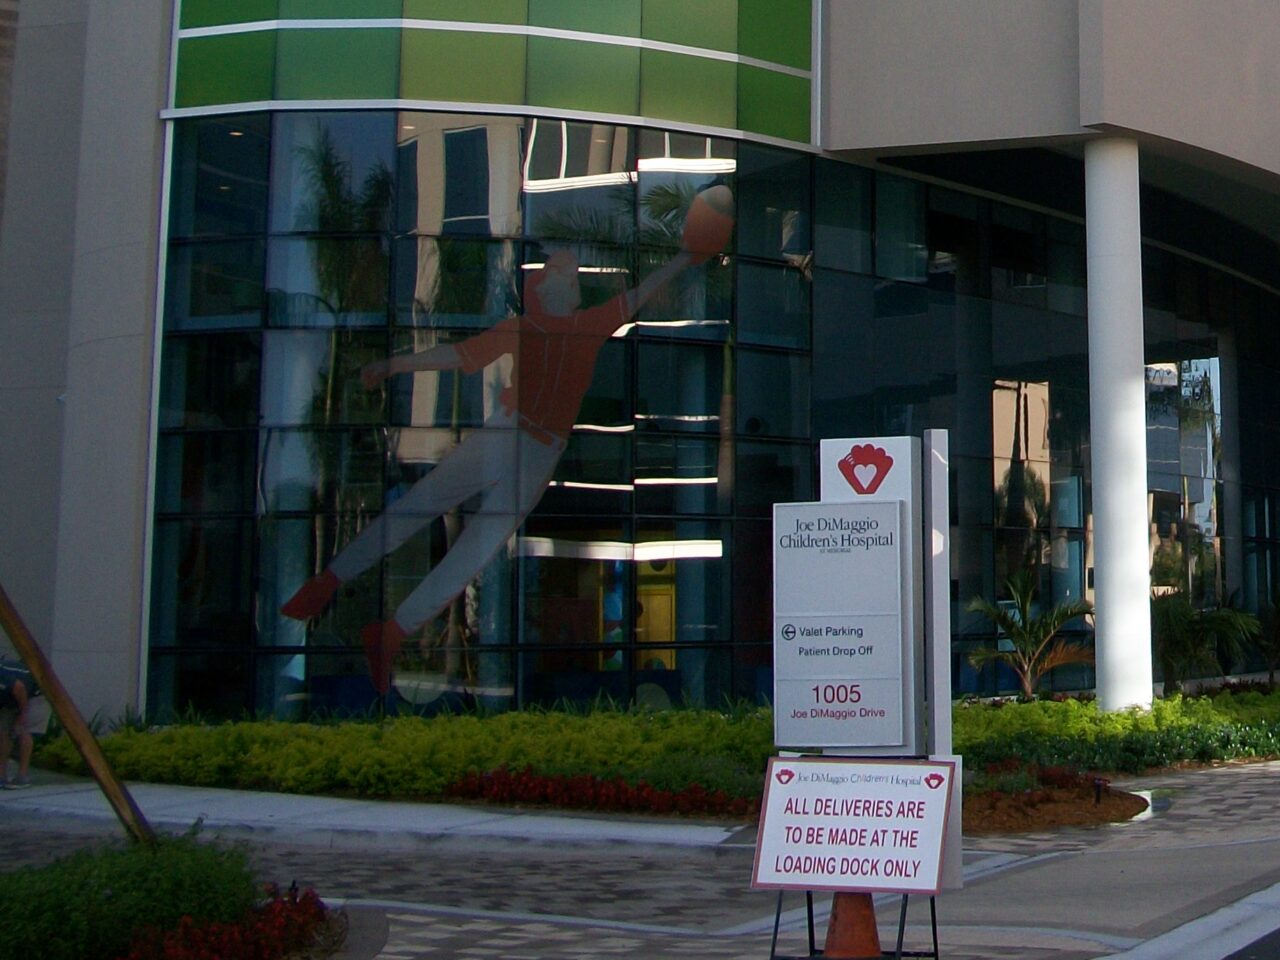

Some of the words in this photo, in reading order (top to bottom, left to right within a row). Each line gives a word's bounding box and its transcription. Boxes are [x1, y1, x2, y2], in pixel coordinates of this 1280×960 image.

[793, 519, 814, 535] Joe
[817, 517, 879, 535] DiMaggio
[779, 534, 838, 548] Children's
[841, 532, 894, 551] Hospital
[799, 626, 823, 637] Valet
[825, 626, 864, 638] Parking
[799, 646, 831, 656] Patient
[832, 646, 856, 658] Drop
[858, 645, 874, 655] Off
[812, 684, 862, 704] 1005
[790, 709, 807, 719] Joe
[810, 708, 857, 720] DiMaggio
[859, 707, 886, 718] Drive
[784, 797, 810, 816] ALL
[814, 798, 893, 818] DELIVERIES
[896, 800, 926, 819] ARE
[785, 826, 802, 844] TO
[806, 827, 824, 845] BE
[828, 828, 867, 847] MADE
[870, 829, 888, 847] AT
[892, 830, 918, 848] THE
[775, 856, 836, 875] LOADING
[840, 857, 881, 876] DOCK
[883, 860, 921, 878] ONLY
